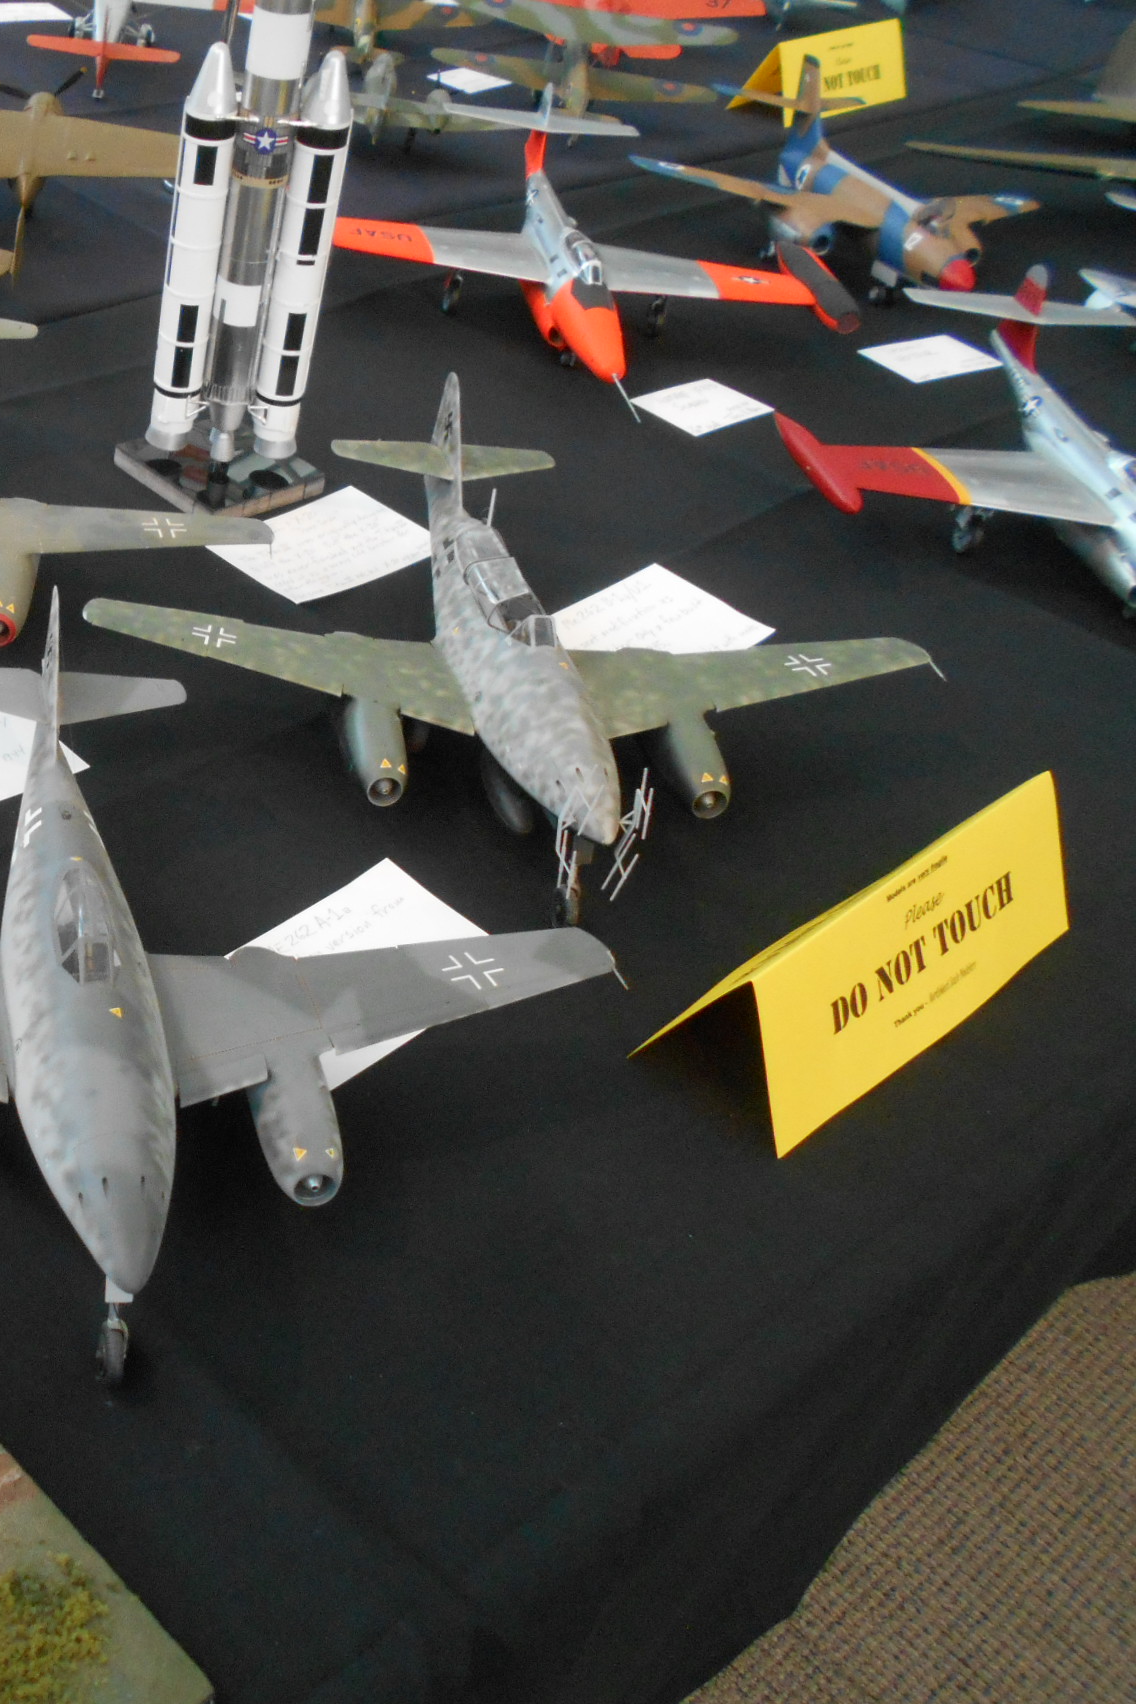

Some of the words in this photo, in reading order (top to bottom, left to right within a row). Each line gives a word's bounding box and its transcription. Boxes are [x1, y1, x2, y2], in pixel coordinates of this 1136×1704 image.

[848, 64, 880, 86] TOUCH
[371, 896, 404, 918] from
[904, 891, 944, 930] Please
[830, 982, 868, 1035] DO
[875, 935, 927, 1002] NOT
[933, 871, 1014, 956] TOUCH
